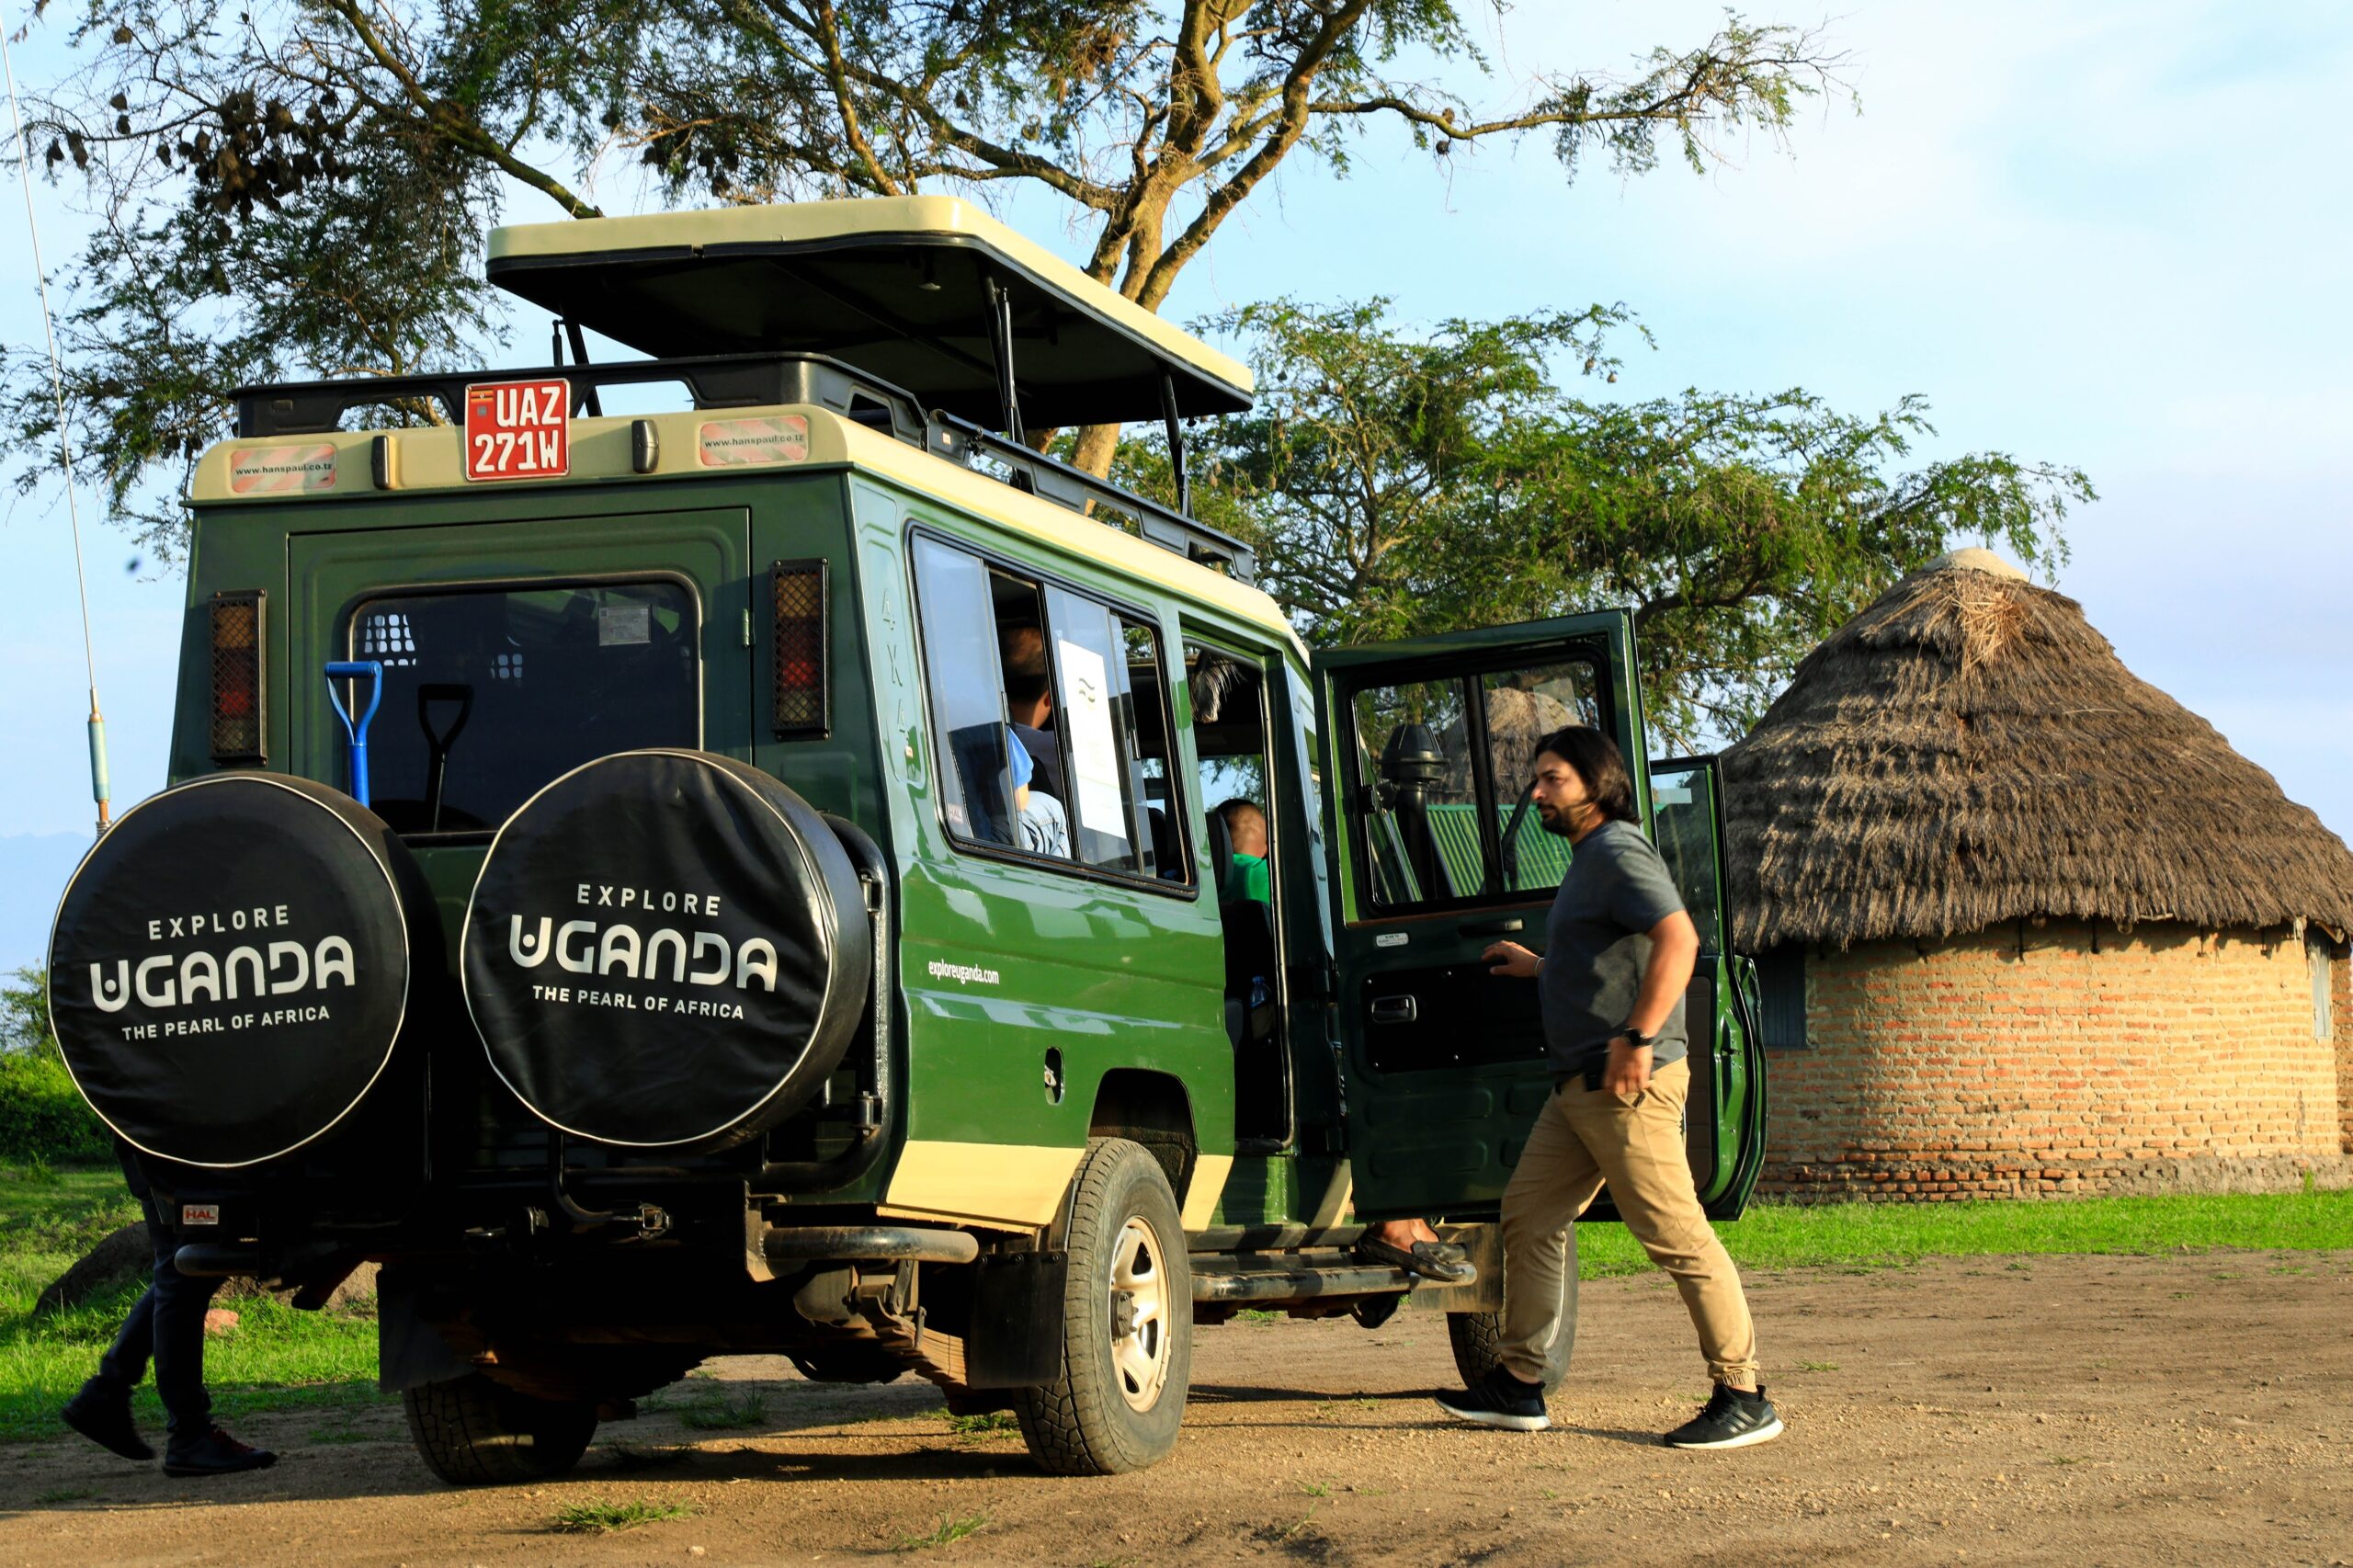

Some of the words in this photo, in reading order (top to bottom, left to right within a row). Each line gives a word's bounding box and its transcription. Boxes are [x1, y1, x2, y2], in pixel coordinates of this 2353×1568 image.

[496, 386, 562, 427] UAZ
[474, 429, 559, 472] 271W
[704, 433, 804, 448] www.hanspaul.co.tz
[235, 462, 332, 475] www.hanspaul.co.tz
[577, 883, 721, 917] EXPLORE
[148, 904, 290, 940] EXPLORE
[509, 914, 778, 993] UGANDA
[928, 958, 1000, 984] exploreuganda.com
[89, 935, 356, 1013] UGANDA
[533, 984, 570, 1003] THE
[577, 989, 637, 1009] PEARL
[644, 995, 668, 1012] OF
[674, 999, 744, 1020] AFRICA
[121, 1024, 157, 1040] THE
[165, 1017, 225, 1037] PEARL
[231, 1015, 254, 1029] OF
[261, 1006, 330, 1027] AFRICA
[186, 1210, 215, 1220] HAL
